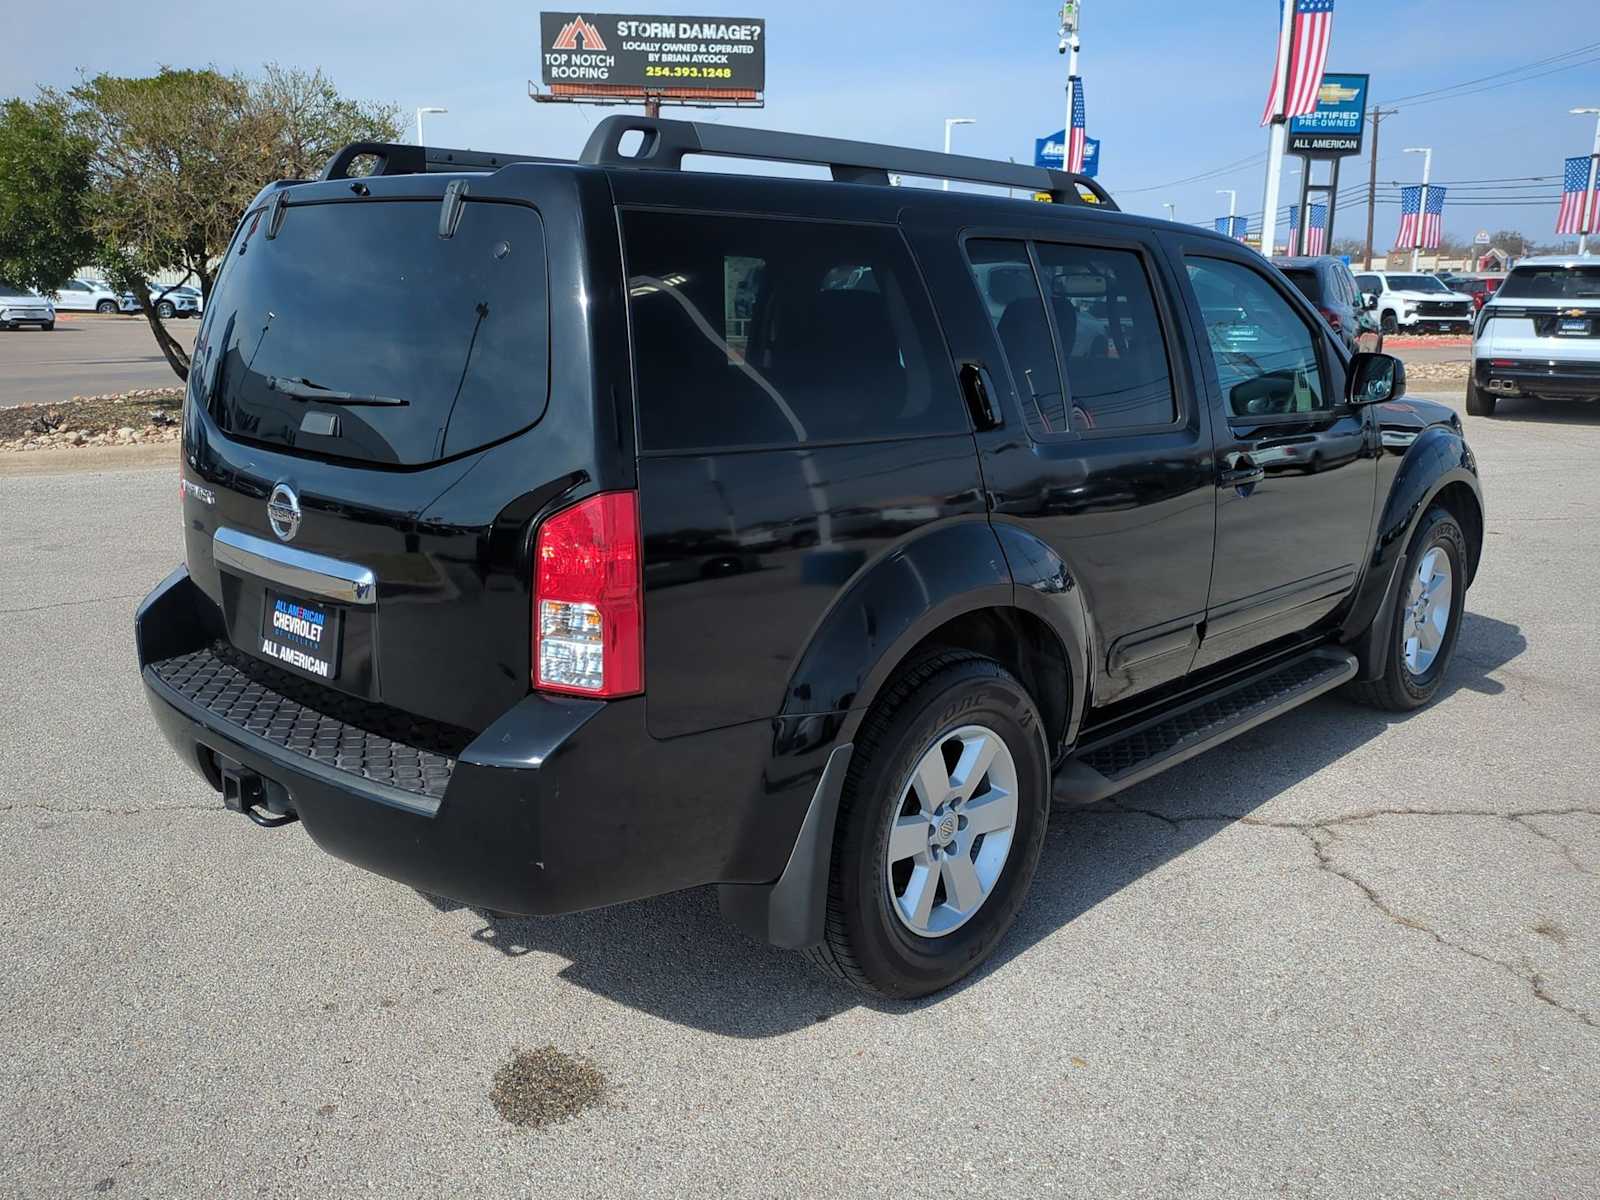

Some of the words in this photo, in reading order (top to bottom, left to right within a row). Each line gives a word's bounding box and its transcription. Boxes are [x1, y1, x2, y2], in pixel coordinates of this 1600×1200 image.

[617, 21, 676, 38] STORM
[678, 23, 761, 41] DAMAGE?
[622, 41, 660, 52] LOCALLY
[661, 43, 698, 53] OWNED
[699, 44, 707, 53] &
[708, 44, 754, 54] OPERATED
[545, 54, 568, 65] TOP
[571, 54, 615, 67] NOTCH
[648, 53, 660, 62] BY
[661, 54, 690, 63] BRIAN
[691, 54, 728, 64] AYCOCK
[551, 67, 609, 79] ROOFING
[645, 66, 731, 78] 254.393.1248
[1298, 119, 1357, 127] PRE-OWNED
[1294, 139, 1310, 149] ALL
[1312, 139, 1358, 149] AMERICAN
[275, 599, 287, 613] ALL
[287, 603, 325, 626] AMERICAN
[272, 610, 324, 643] CHEVROLET
[262, 638, 279, 659] ALL
[279, 646, 329, 677] AMERICAN
